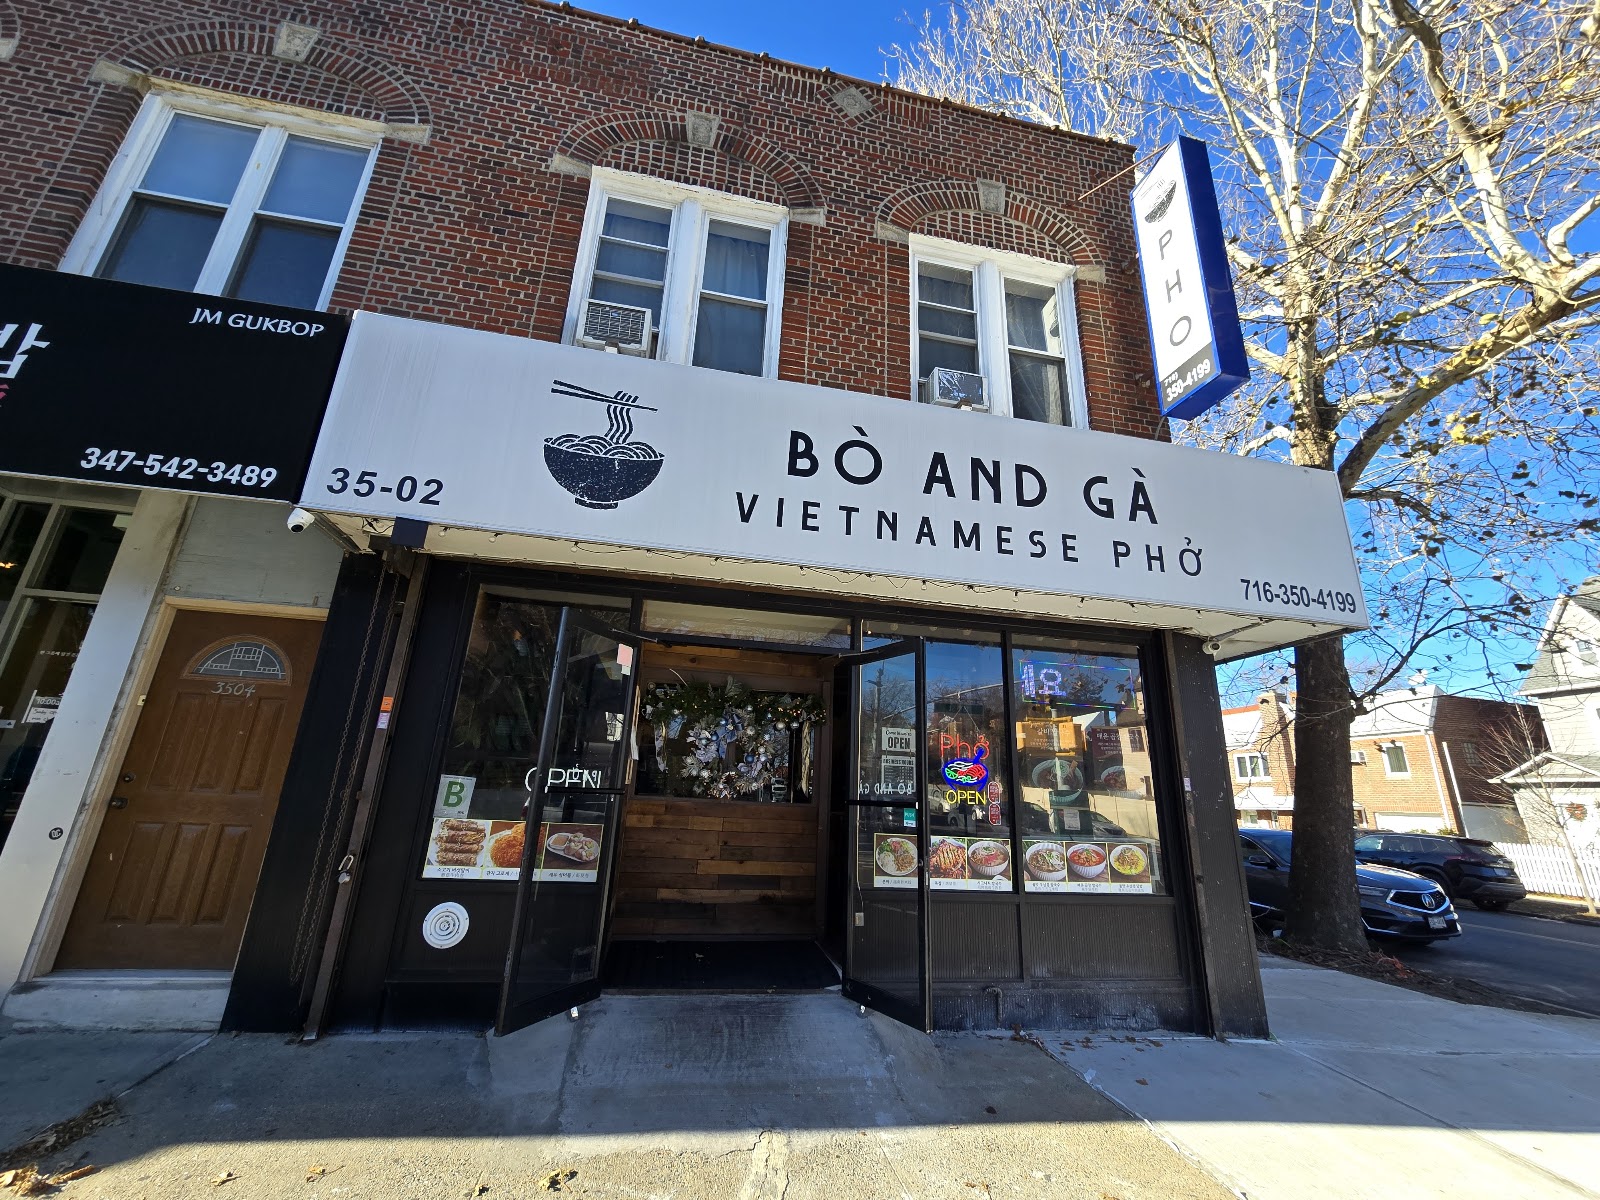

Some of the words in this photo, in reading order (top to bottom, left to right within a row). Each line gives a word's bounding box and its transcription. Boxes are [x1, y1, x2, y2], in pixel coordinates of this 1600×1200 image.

[1158, 229, 1192, 347] PHO
[189, 307, 221, 326] JM
[227, 312, 325, 338] GUKBOP
[1166, 358, 1211, 402] 350-4199
[80, 447, 278, 488] 347-542-3489
[787, 424, 883, 485] BÒ
[922, 451, 1048, 508] AND
[1083, 467, 1158, 525] GÀ
[326, 467, 445, 506] 35-02
[735, 491, 1080, 564] VIETNAMESE
[1112, 536, 1203, 577] PHỞ
[1240, 578, 1358, 614] 716-350-4199
[211, 681, 256, 699] 3504
[887, 736, 911, 749] OPEN
[443, 781, 465, 807] B
[946, 789, 987, 805] OPEN
